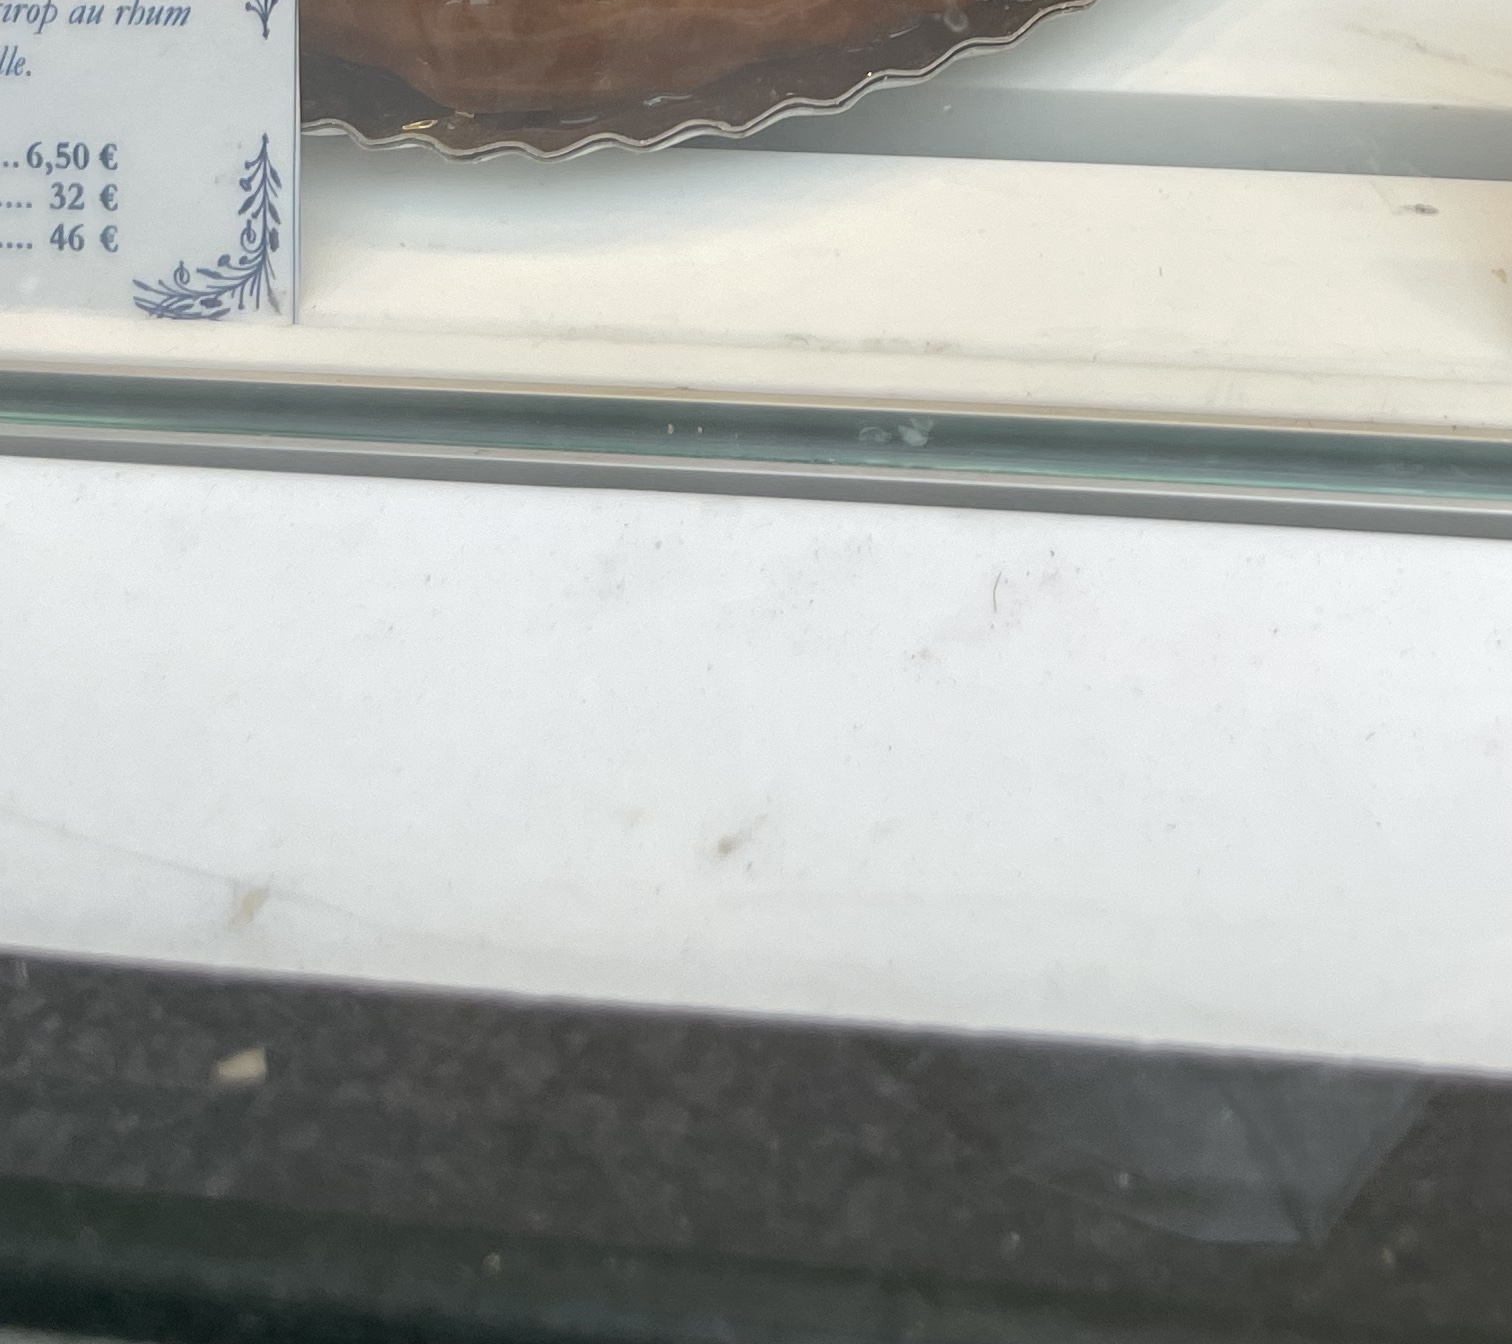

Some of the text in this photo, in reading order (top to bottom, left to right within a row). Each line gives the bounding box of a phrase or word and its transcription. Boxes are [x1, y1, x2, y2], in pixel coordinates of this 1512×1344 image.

[68, 4, 105, 25] au
[26, 141, 119, 176] 6,50 €
[49, 181, 119, 212] 32 €
[49, 223, 119, 253] 46 €
